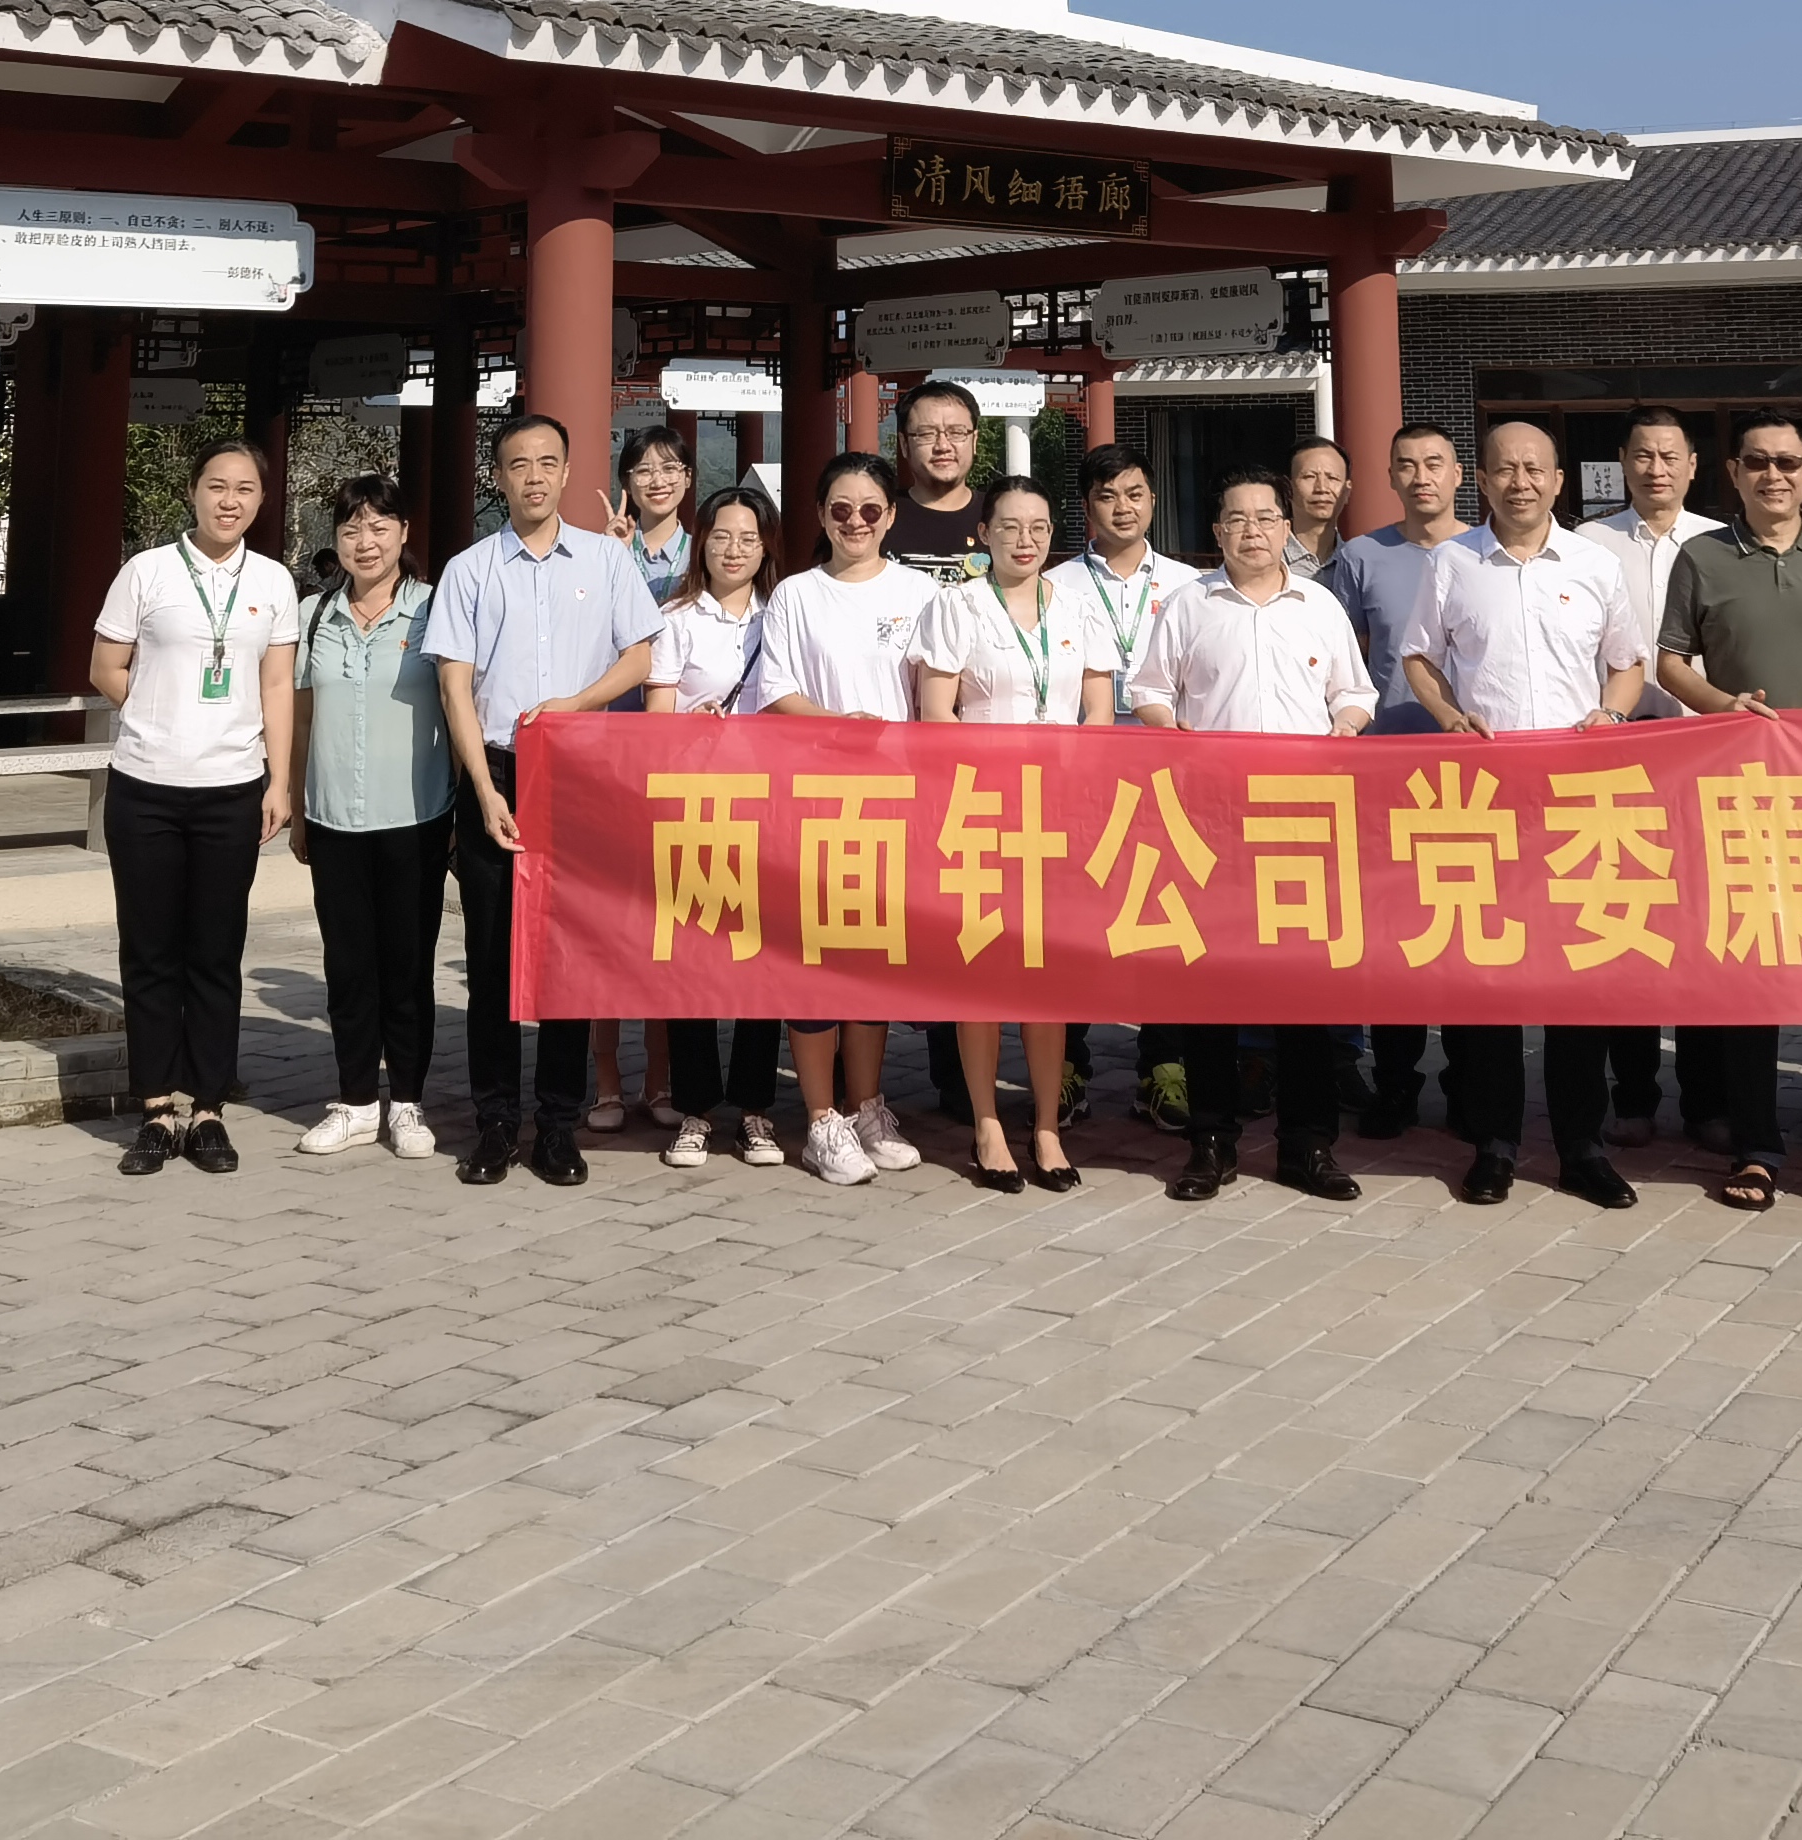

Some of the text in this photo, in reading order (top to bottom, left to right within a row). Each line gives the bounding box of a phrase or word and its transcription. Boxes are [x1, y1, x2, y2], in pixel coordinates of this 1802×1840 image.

[913, 154, 1132, 221] 清风细语廊
